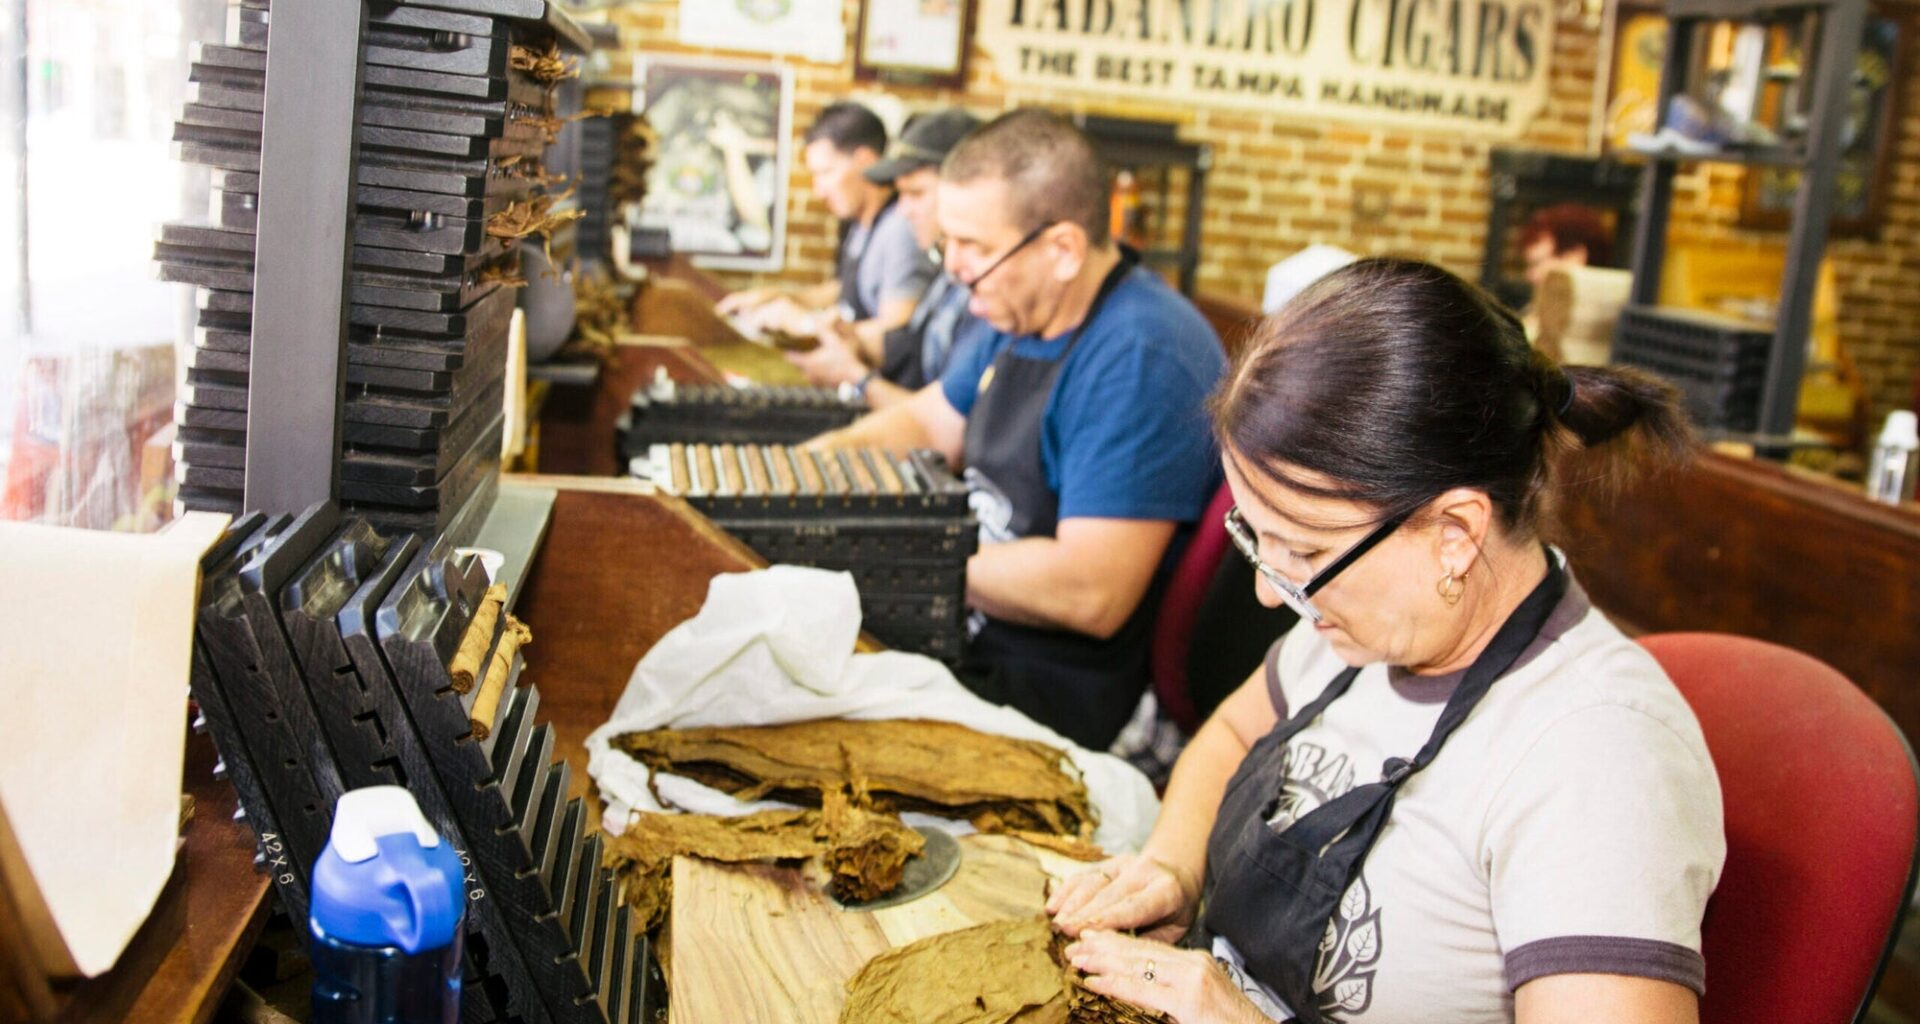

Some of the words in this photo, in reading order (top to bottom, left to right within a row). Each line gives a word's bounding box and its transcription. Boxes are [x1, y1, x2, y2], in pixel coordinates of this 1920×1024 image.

[1347, 0, 1542, 83] CIGARS
[1020, 47, 1075, 76] THE
[1096, 55, 1173, 85] BEST
[1194, 64, 1303, 98] TAMPA
[1321, 82, 1509, 123] HANDMADE
